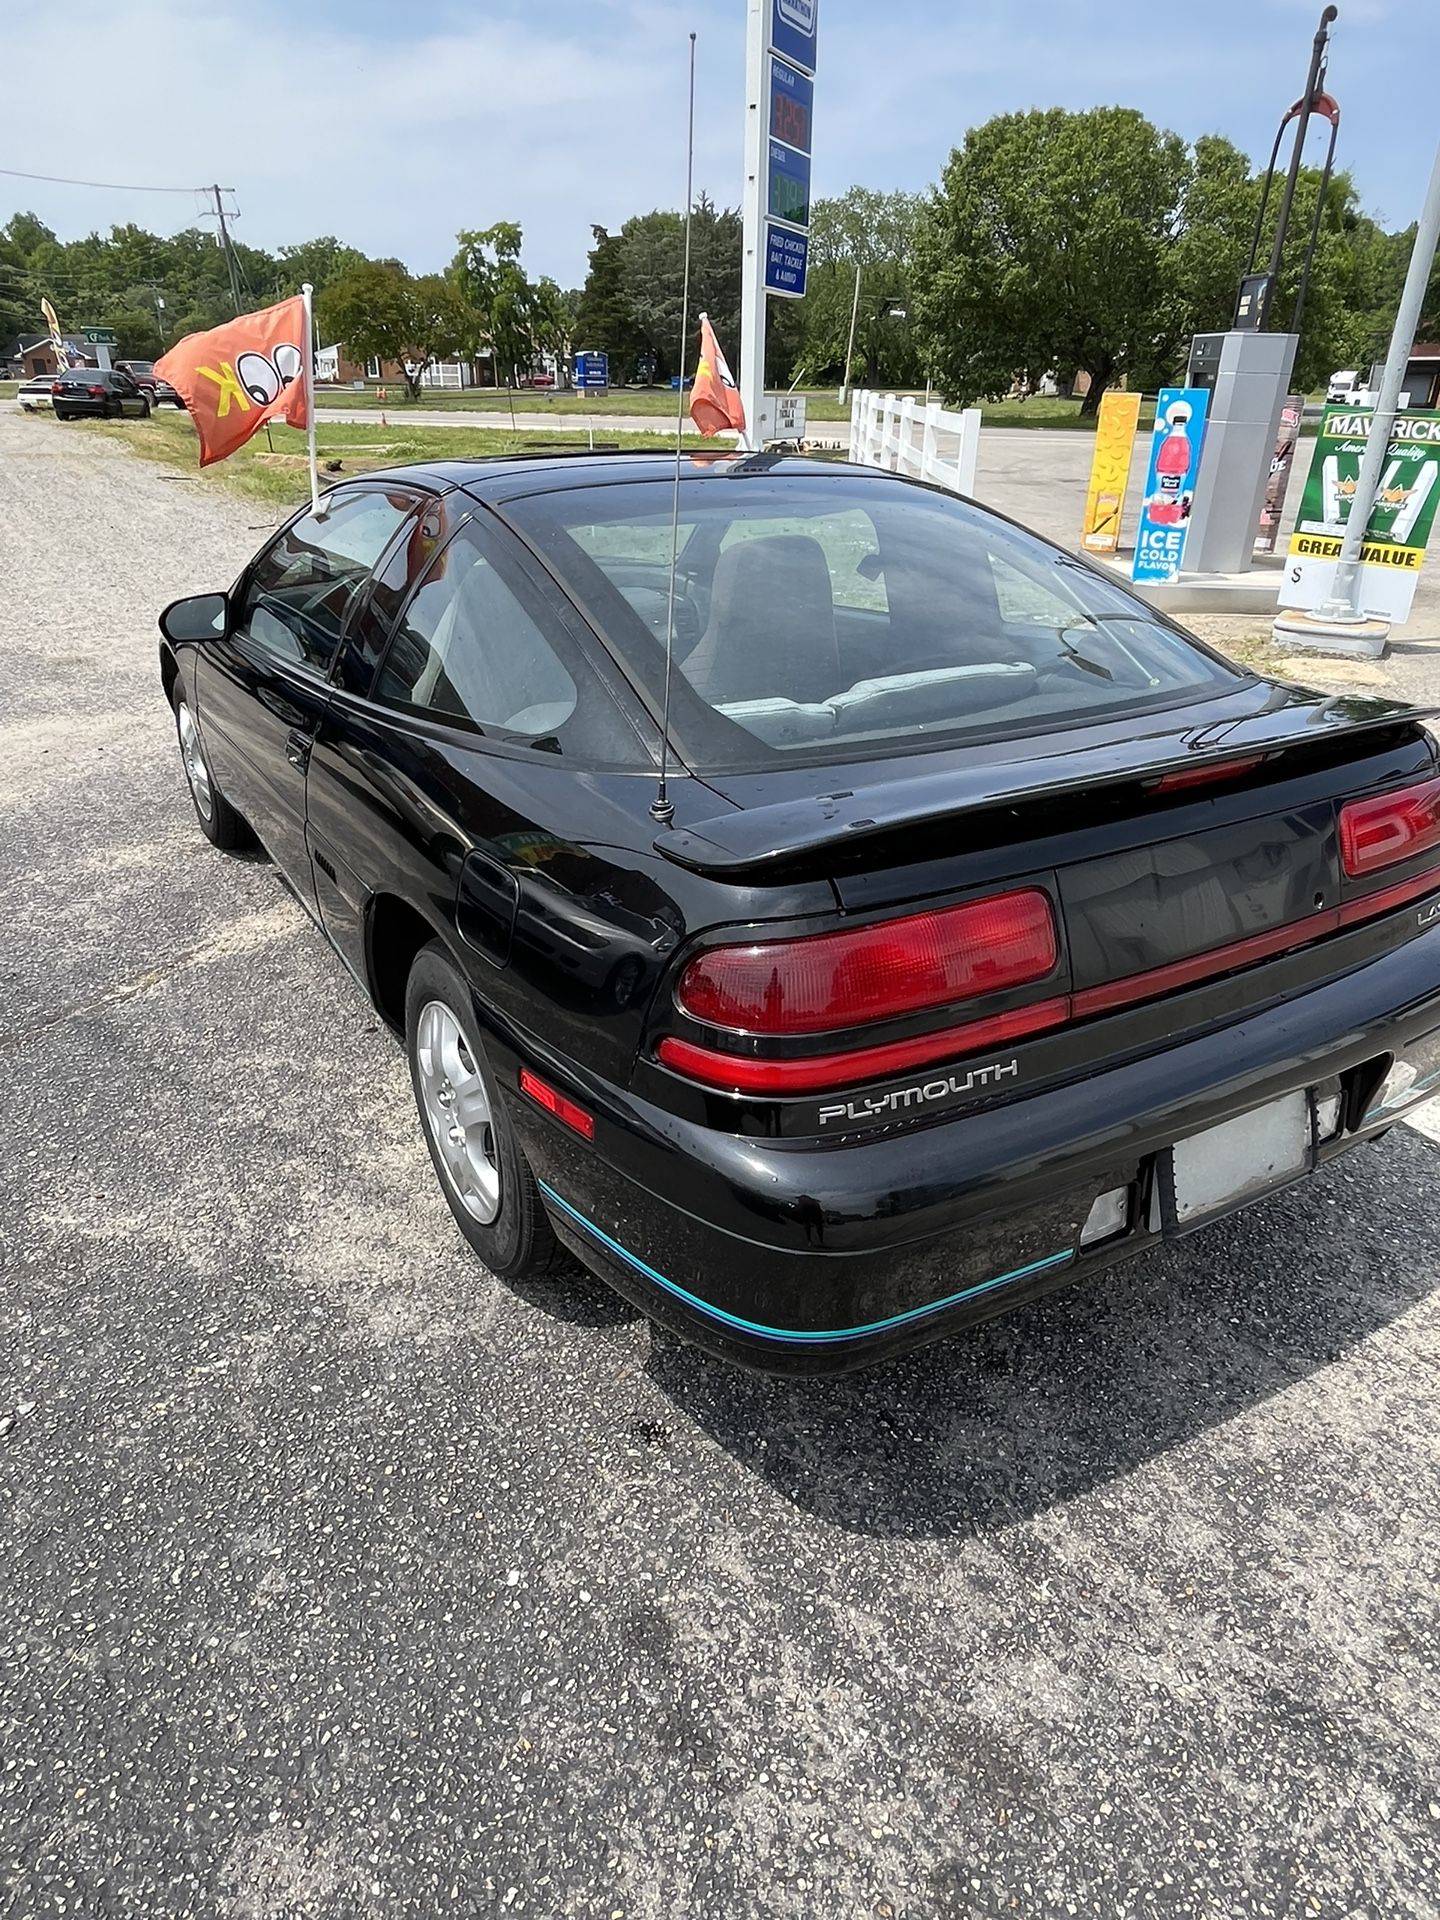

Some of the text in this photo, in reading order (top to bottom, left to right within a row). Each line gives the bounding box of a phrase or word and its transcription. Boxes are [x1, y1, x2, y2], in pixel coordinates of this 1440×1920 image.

[770, 233, 806, 255] FRIED CHICKEN
[784, 254, 803, 270] TACKLE
[1330, 414, 1440, 441] MAVRICK
[1386, 442, 1427, 462] Quality
[1142, 530, 1181, 550] ICE
[1140, 549, 1178, 562] COLD
[1297, 538, 1417, 567] GREA VALUE
[1417, 903, 1440, 926] LA
[818, 1058, 1019, 1126] PLYMOUTH
